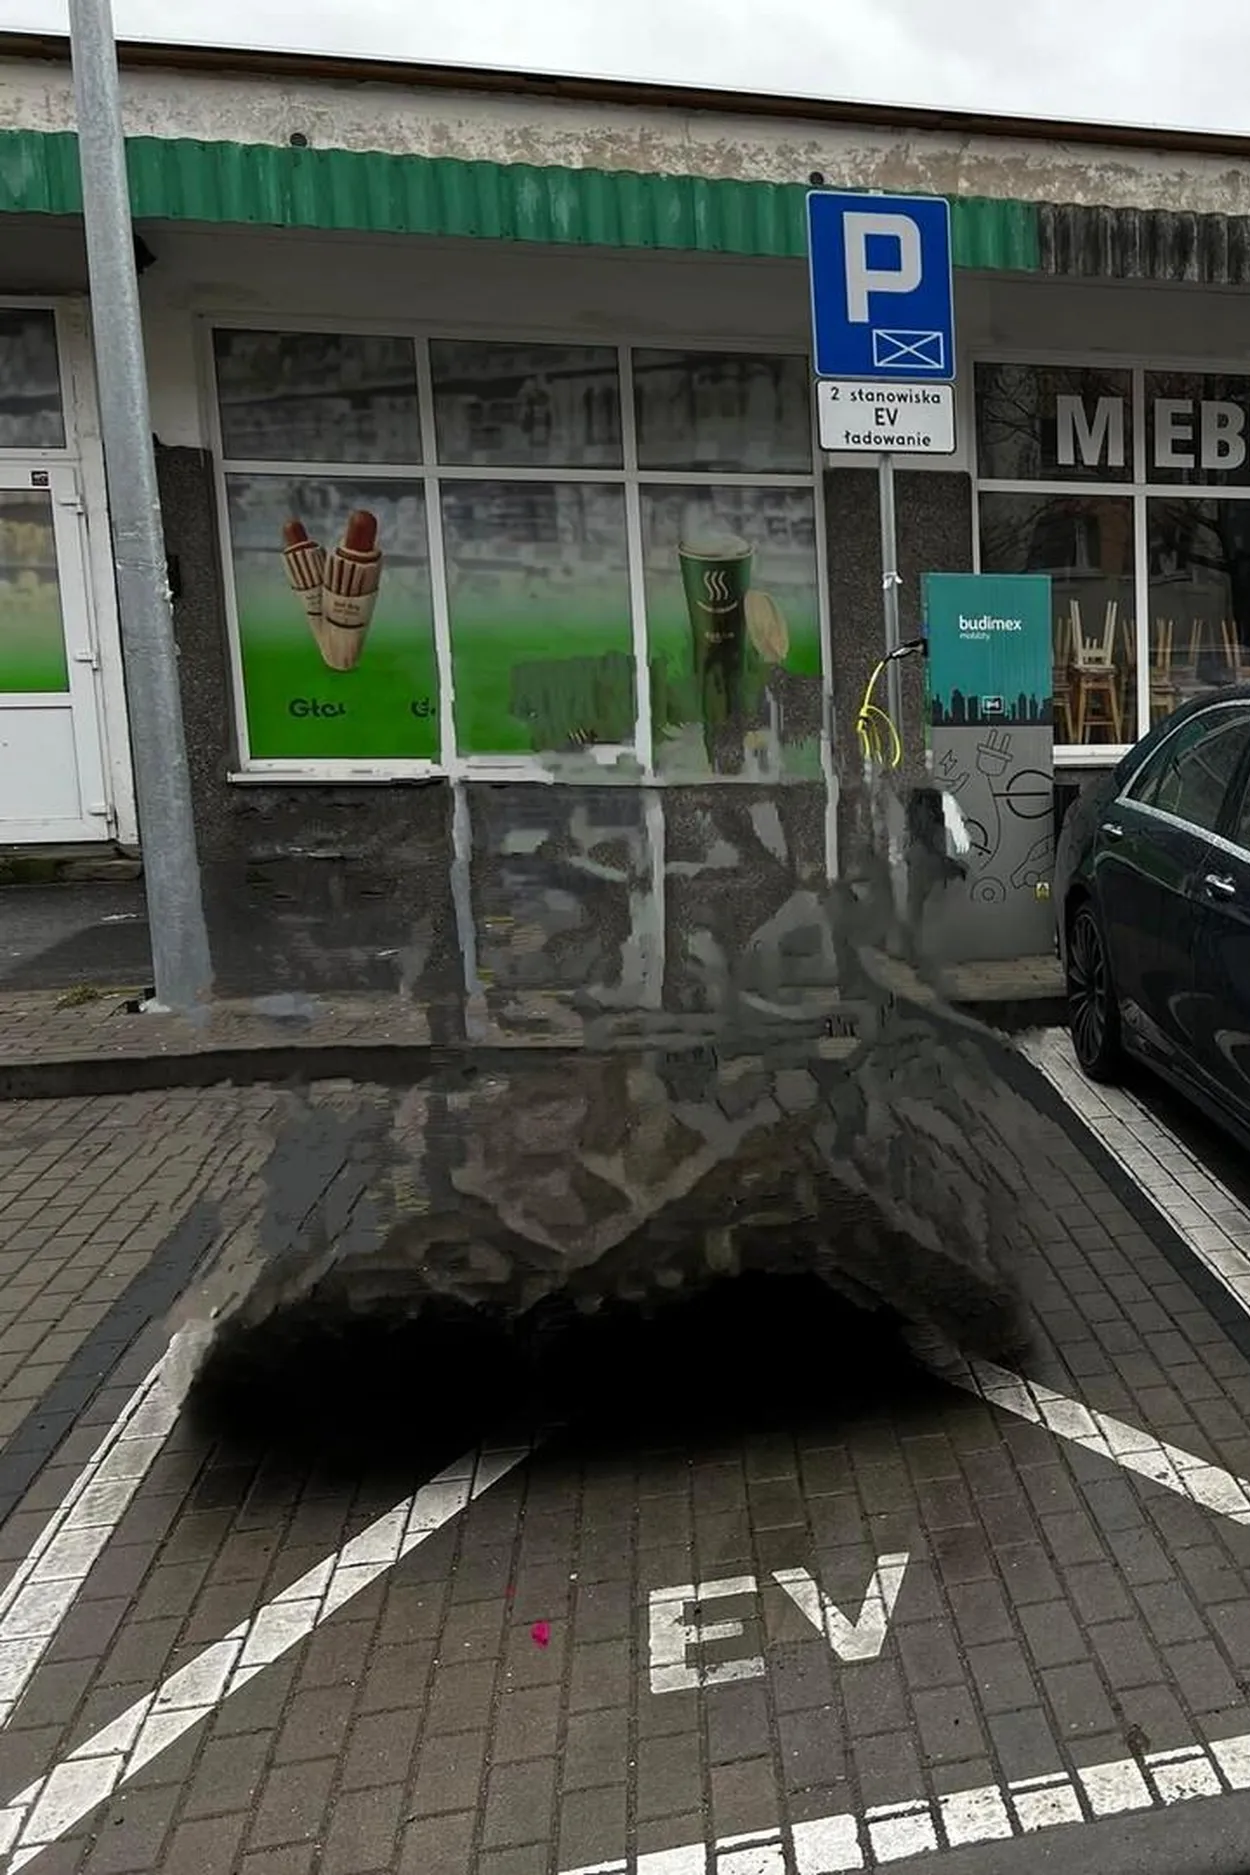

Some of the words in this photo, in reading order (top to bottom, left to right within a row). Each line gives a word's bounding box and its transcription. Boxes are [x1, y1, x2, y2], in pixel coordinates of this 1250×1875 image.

[843, 211, 922, 323] P
[830, 386, 840, 401] 2
[850, 388, 941, 404] stanowiska
[875, 407, 898, 427] EV
[844, 430, 932, 447] ładowanie
[958, 614, 1022, 631] budimex
[649, 1552, 910, 1694] EV
